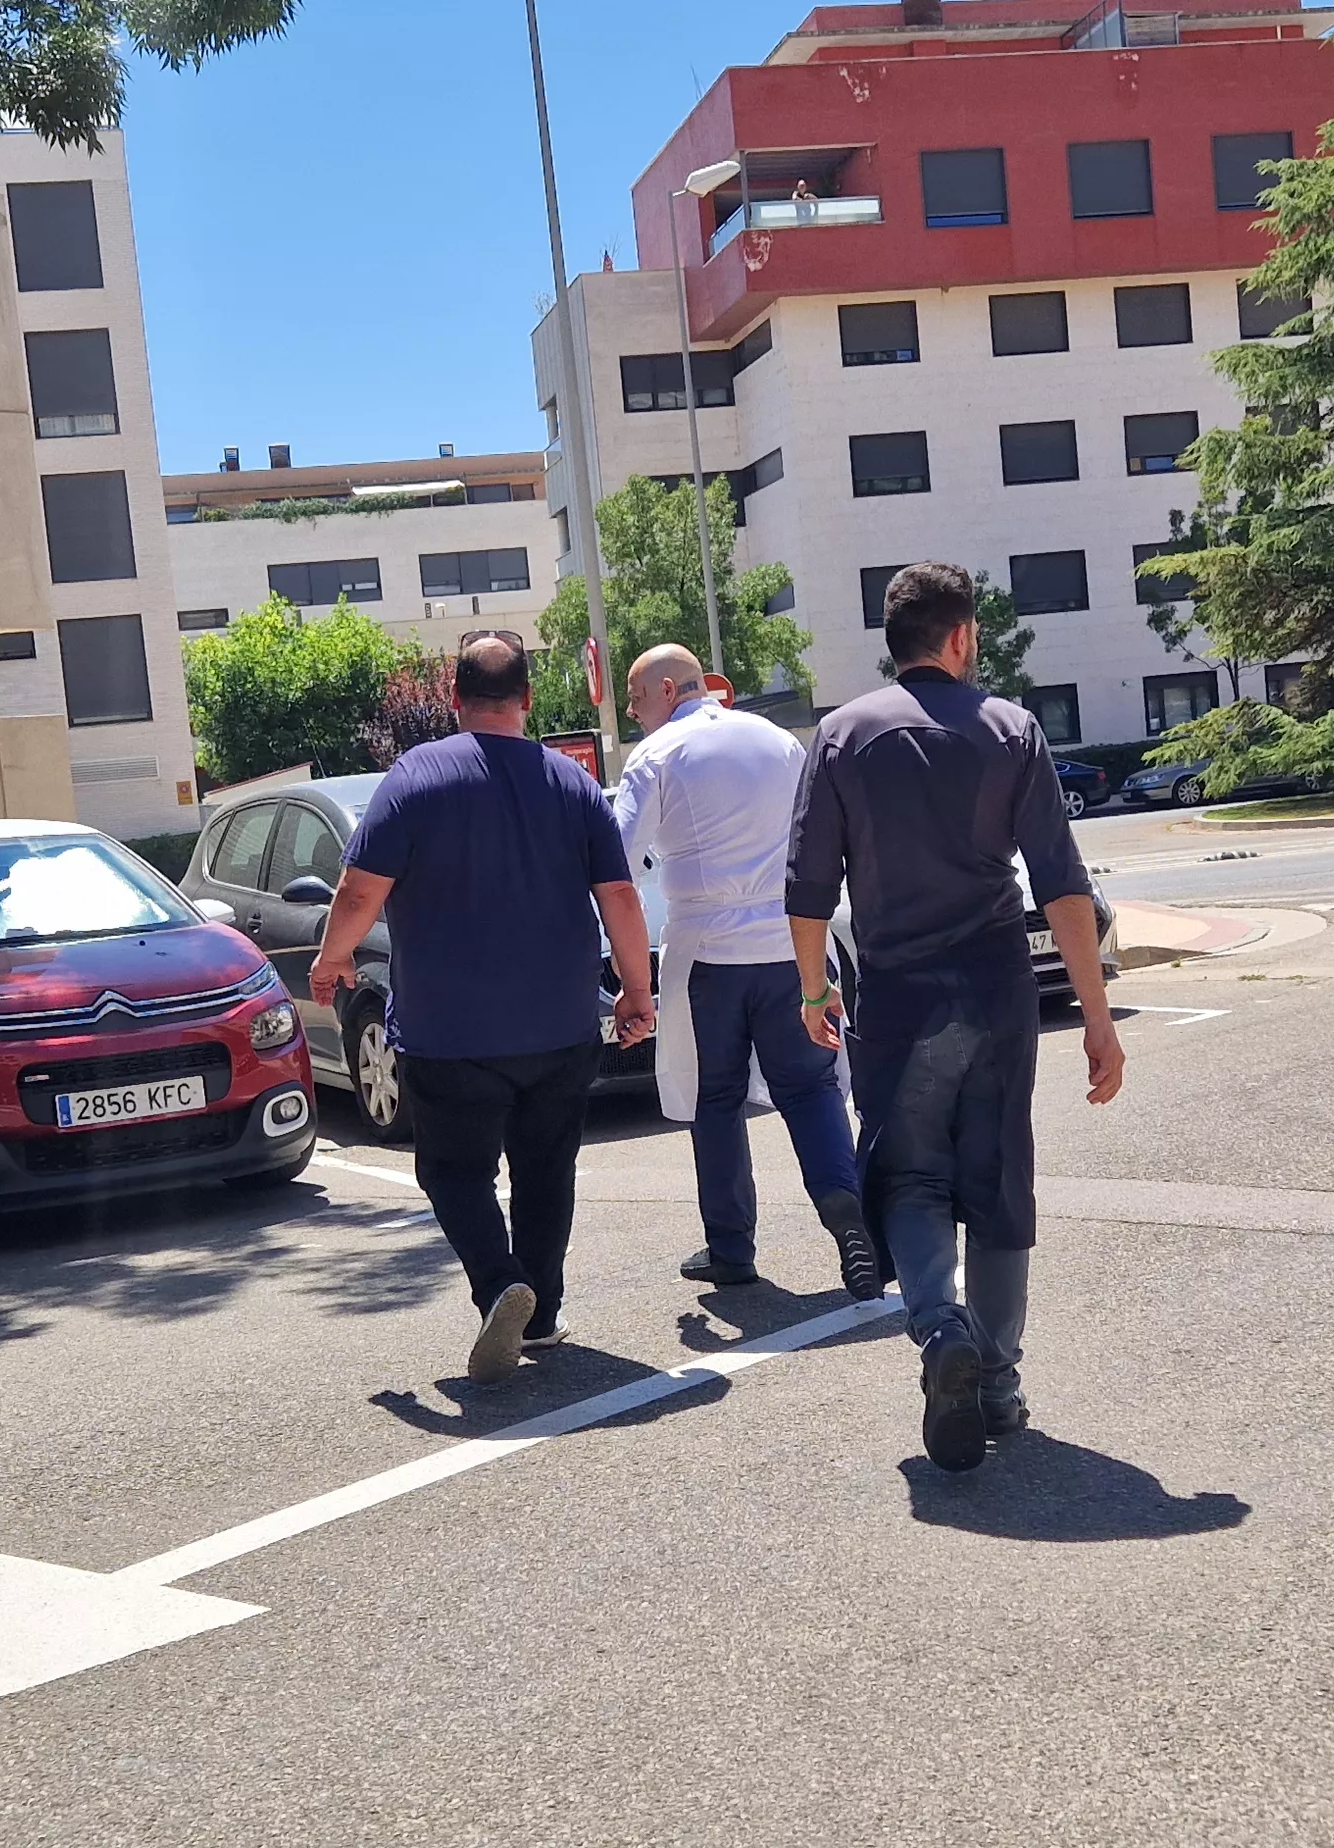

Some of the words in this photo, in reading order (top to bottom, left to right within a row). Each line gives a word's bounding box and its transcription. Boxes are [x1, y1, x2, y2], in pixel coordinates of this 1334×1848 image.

[1031, 934, 1047, 950] 47
[76, 1091, 137, 1121] 2856
[147, 1083, 192, 1110] KFC
